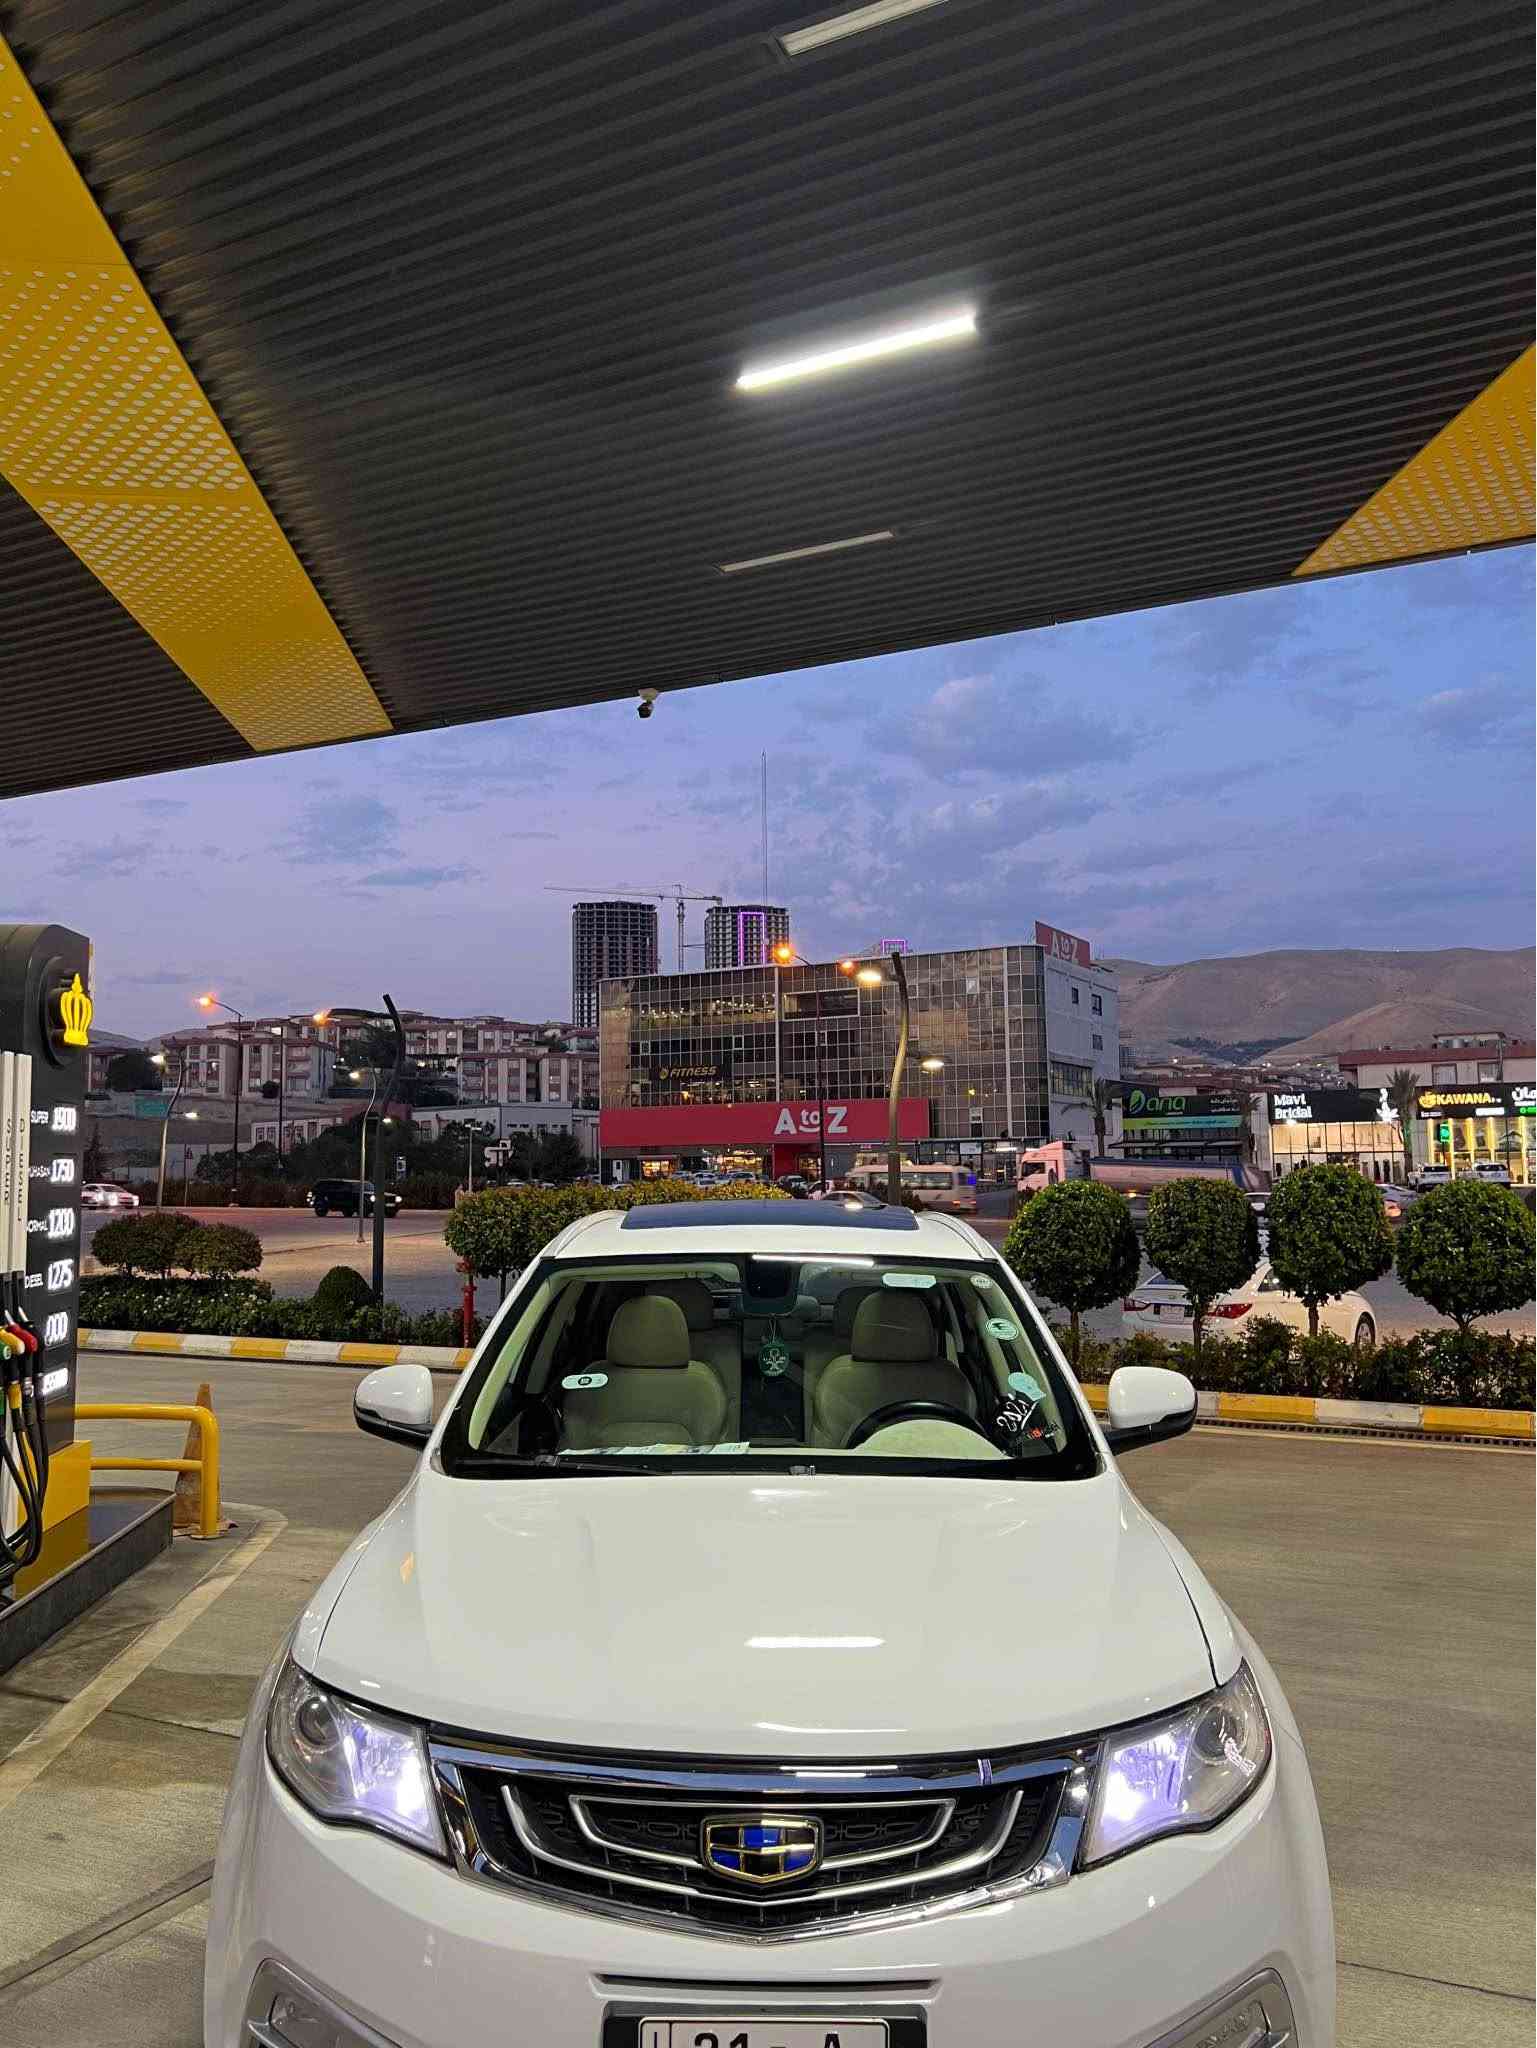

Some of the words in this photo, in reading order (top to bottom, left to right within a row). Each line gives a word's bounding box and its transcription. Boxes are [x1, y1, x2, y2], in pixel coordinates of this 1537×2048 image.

[671, 1065, 718, 1079] FITNESS
[1436, 1091, 1492, 1106] KAWANA
[1274, 1105, 1312, 1120] Bridal
